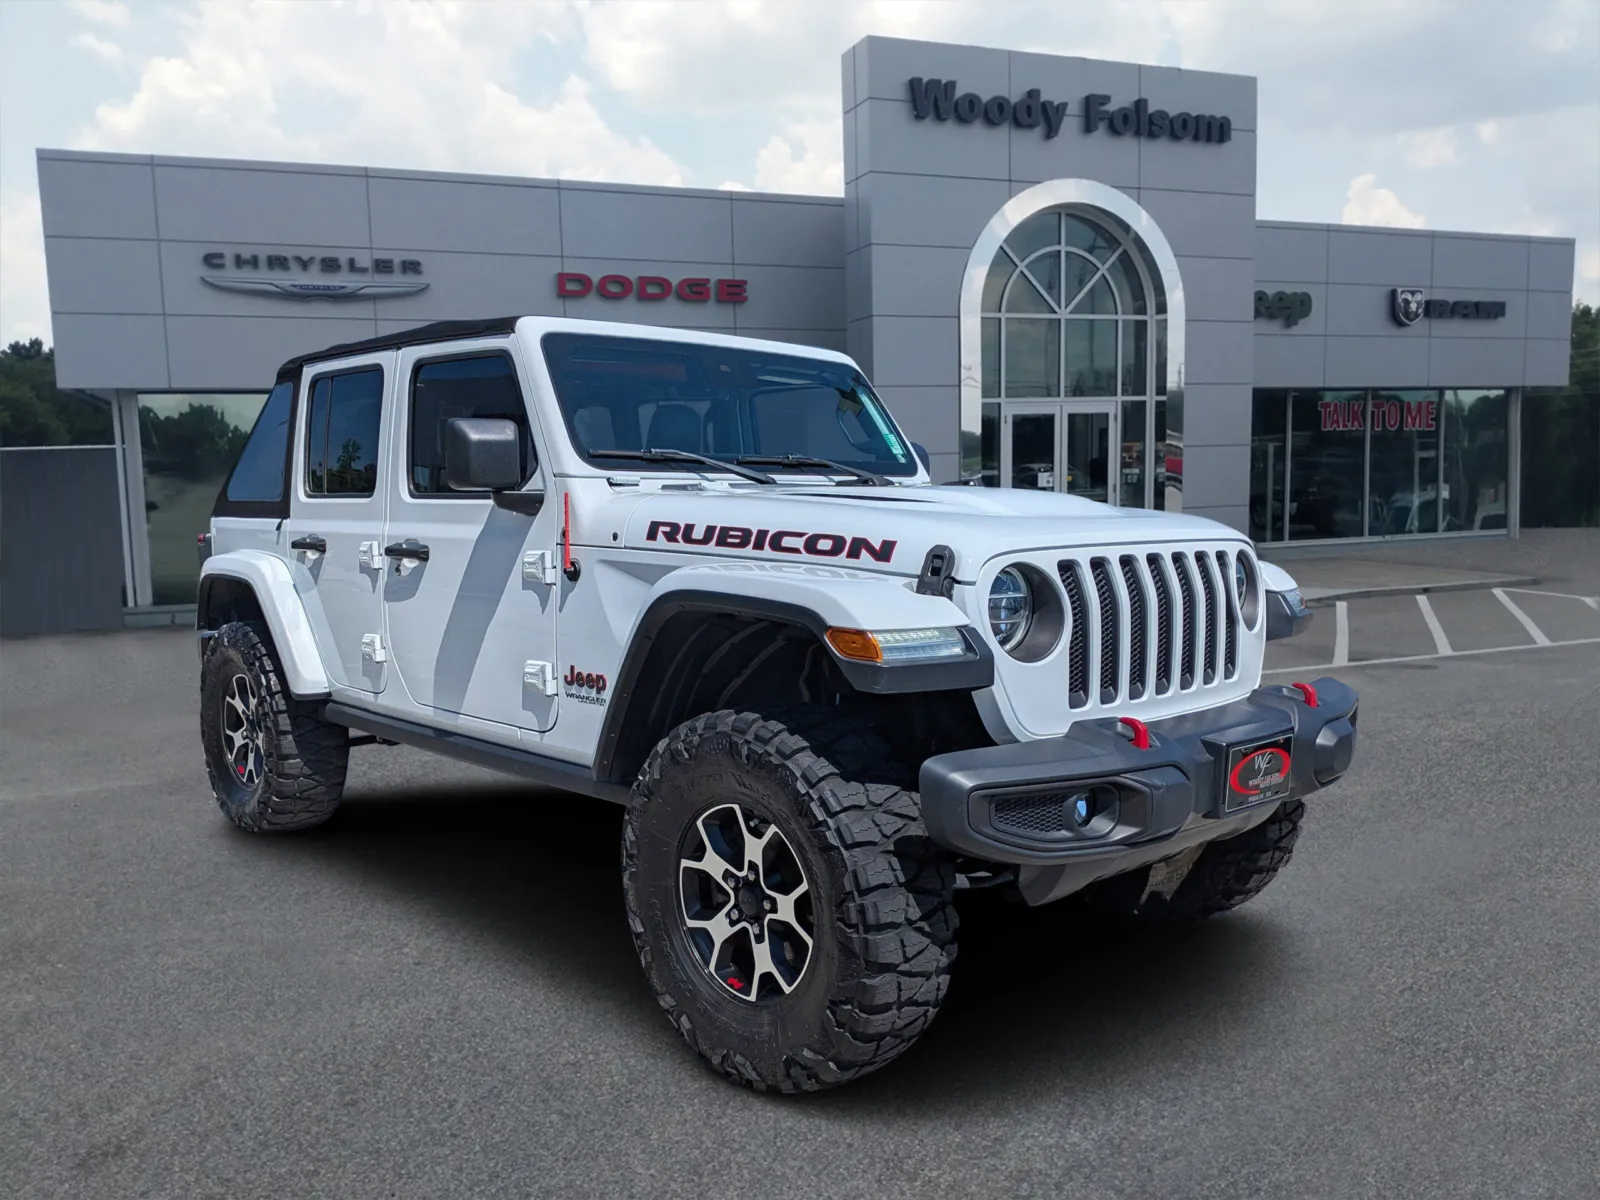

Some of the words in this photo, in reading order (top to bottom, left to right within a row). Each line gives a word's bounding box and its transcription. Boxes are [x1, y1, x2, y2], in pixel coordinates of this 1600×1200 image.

[909, 76, 1069, 139] Woody
[1084, 93, 1232, 143] Folsom
[202, 252, 424, 275] CHRYSLER
[556, 272, 749, 303] DODGE
[1254, 290, 1312, 328] eep
[1423, 299, 1506, 319] RAM
[1318, 400, 1364, 430] TALK
[1371, 400, 1400, 430] TO
[1403, 400, 1436, 430] ME
[645, 520, 898, 563] RUBICON
[563, 664, 607, 694] Jeep
[565, 691, 606, 704] WRANGLER
